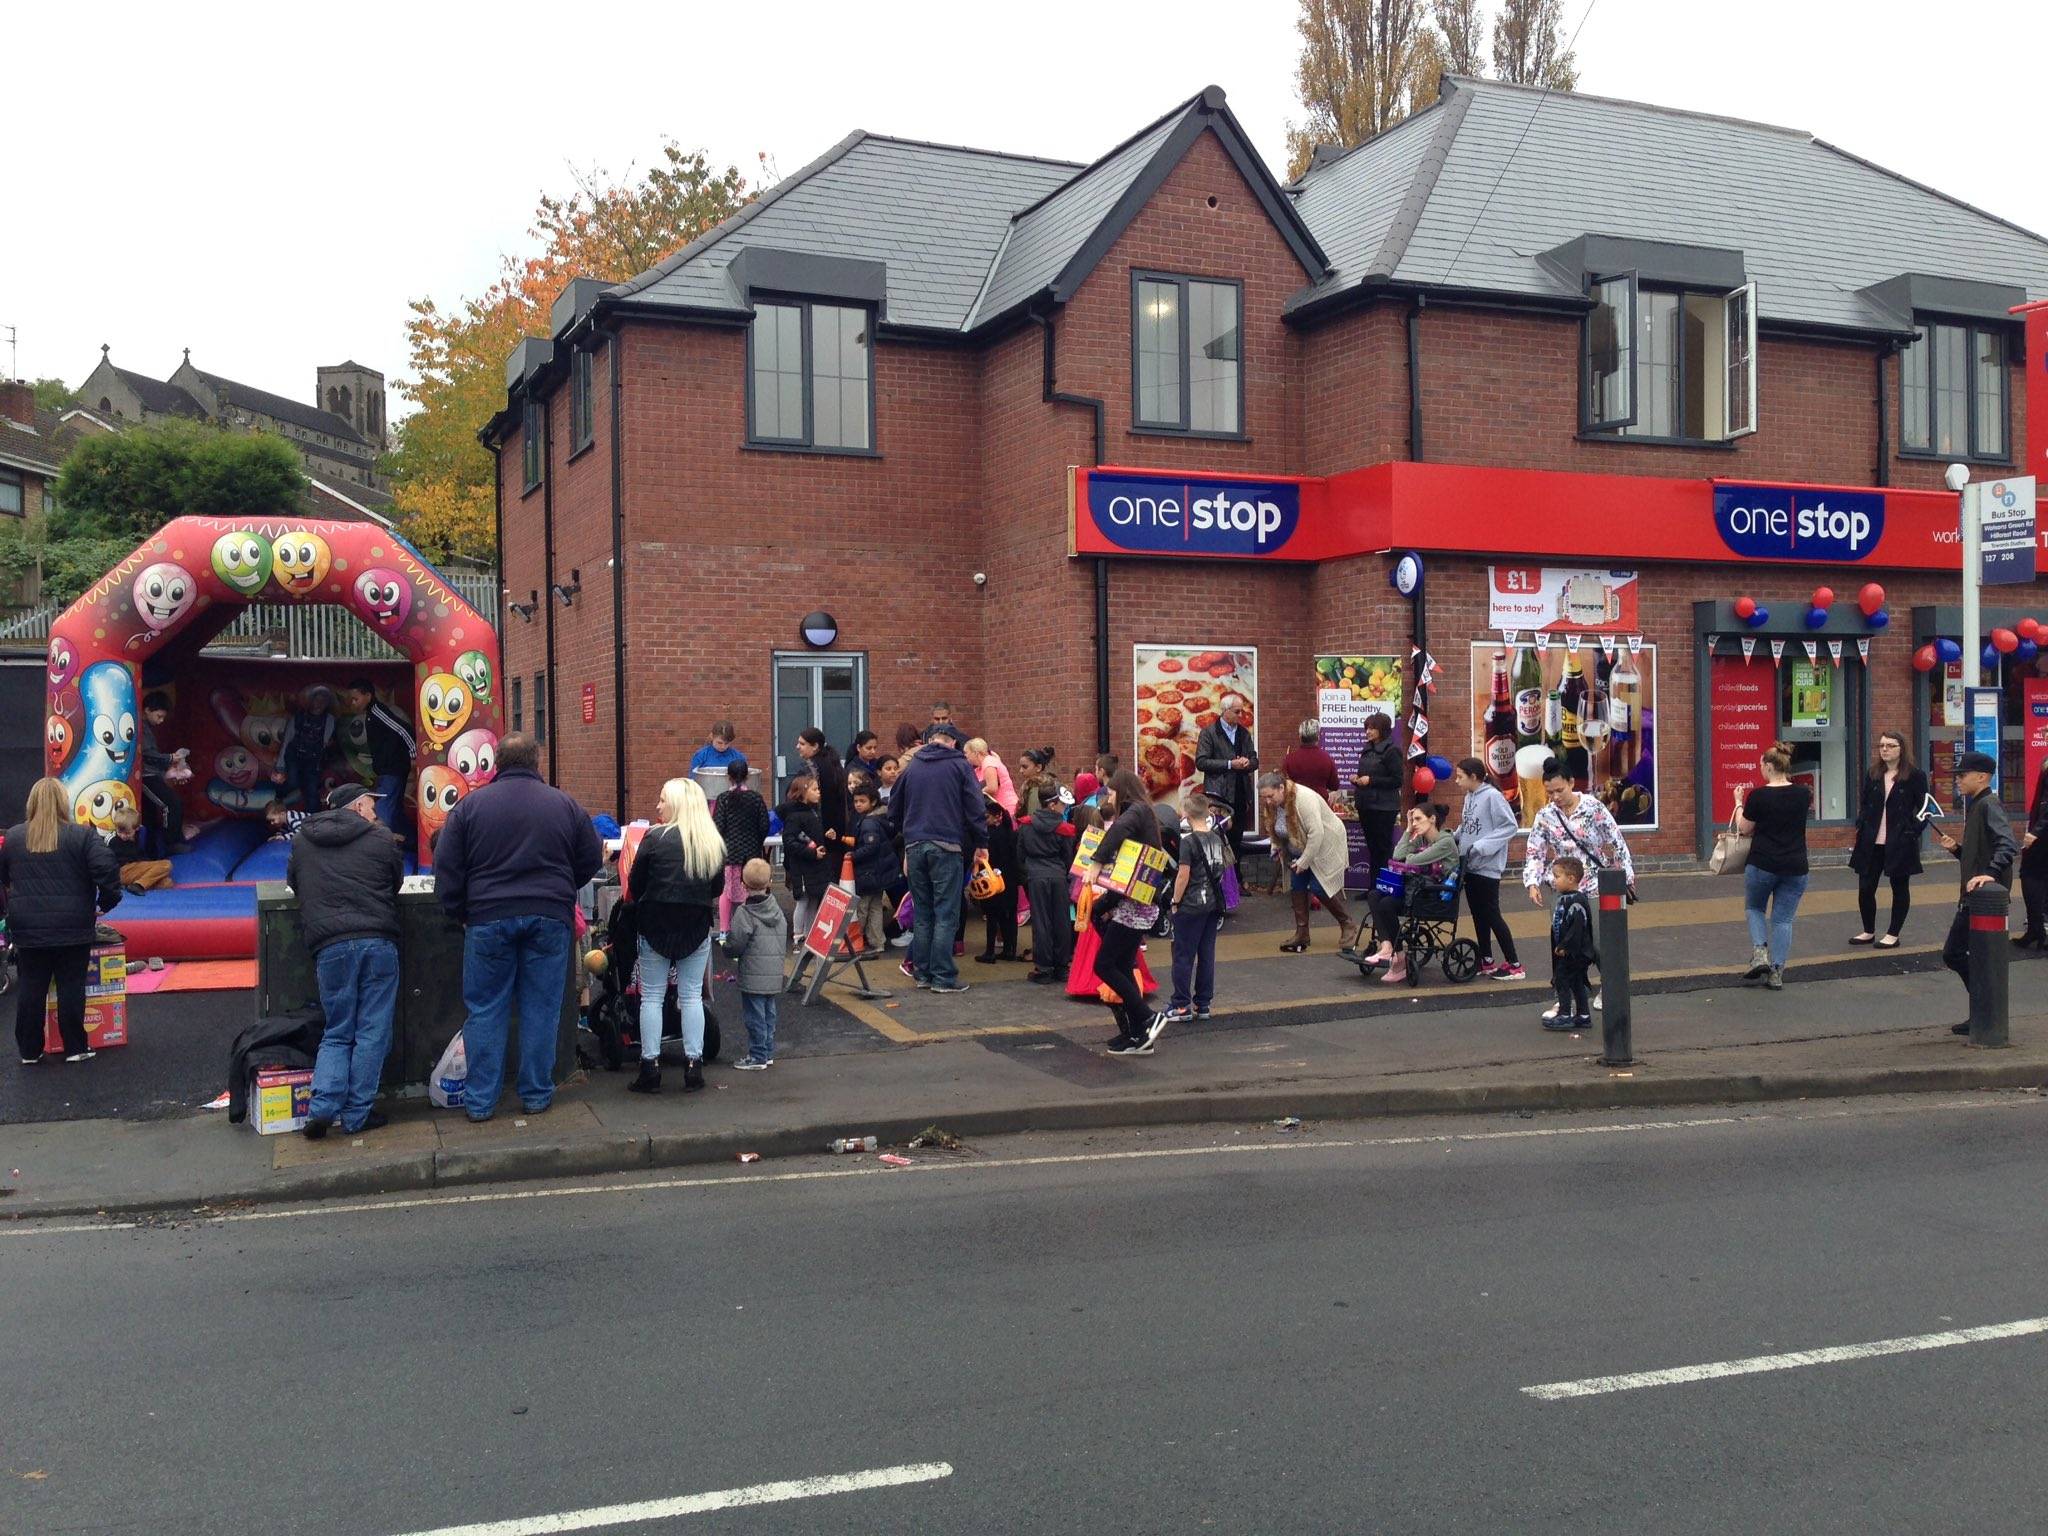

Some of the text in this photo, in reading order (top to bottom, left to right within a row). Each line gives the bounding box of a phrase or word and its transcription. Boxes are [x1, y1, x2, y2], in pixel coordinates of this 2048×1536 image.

[1109, 491, 1282, 543] one stop
[1991, 509, 2026, 519] Bus Stop
[1730, 502, 1871, 551] one stop
[1492, 603, 1544, 615] here to stay!
[1322, 693, 1339, 701] Join
[1322, 703, 1381, 714] FREE healthy
[1322, 716, 1358, 725] cooking
